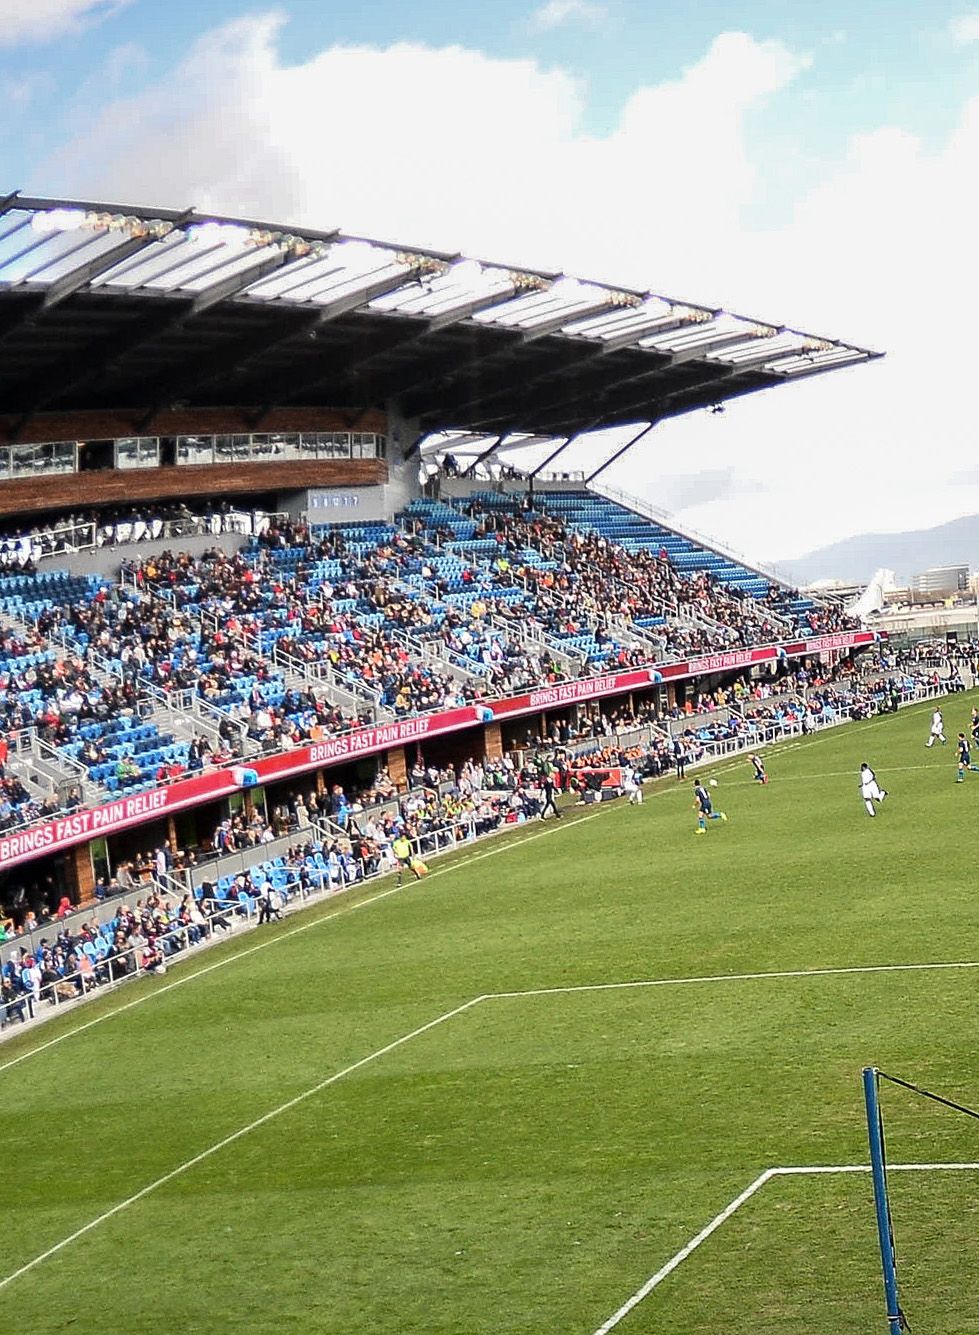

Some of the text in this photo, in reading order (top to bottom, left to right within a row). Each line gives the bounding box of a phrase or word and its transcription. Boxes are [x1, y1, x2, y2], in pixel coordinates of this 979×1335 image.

[558, 685, 577, 700] FAST
[310, 719, 430, 762] BRINGS FAST PAIN RELIEF
[0, 789, 169, 861] BRINGS FAST PAIN RELIEF
